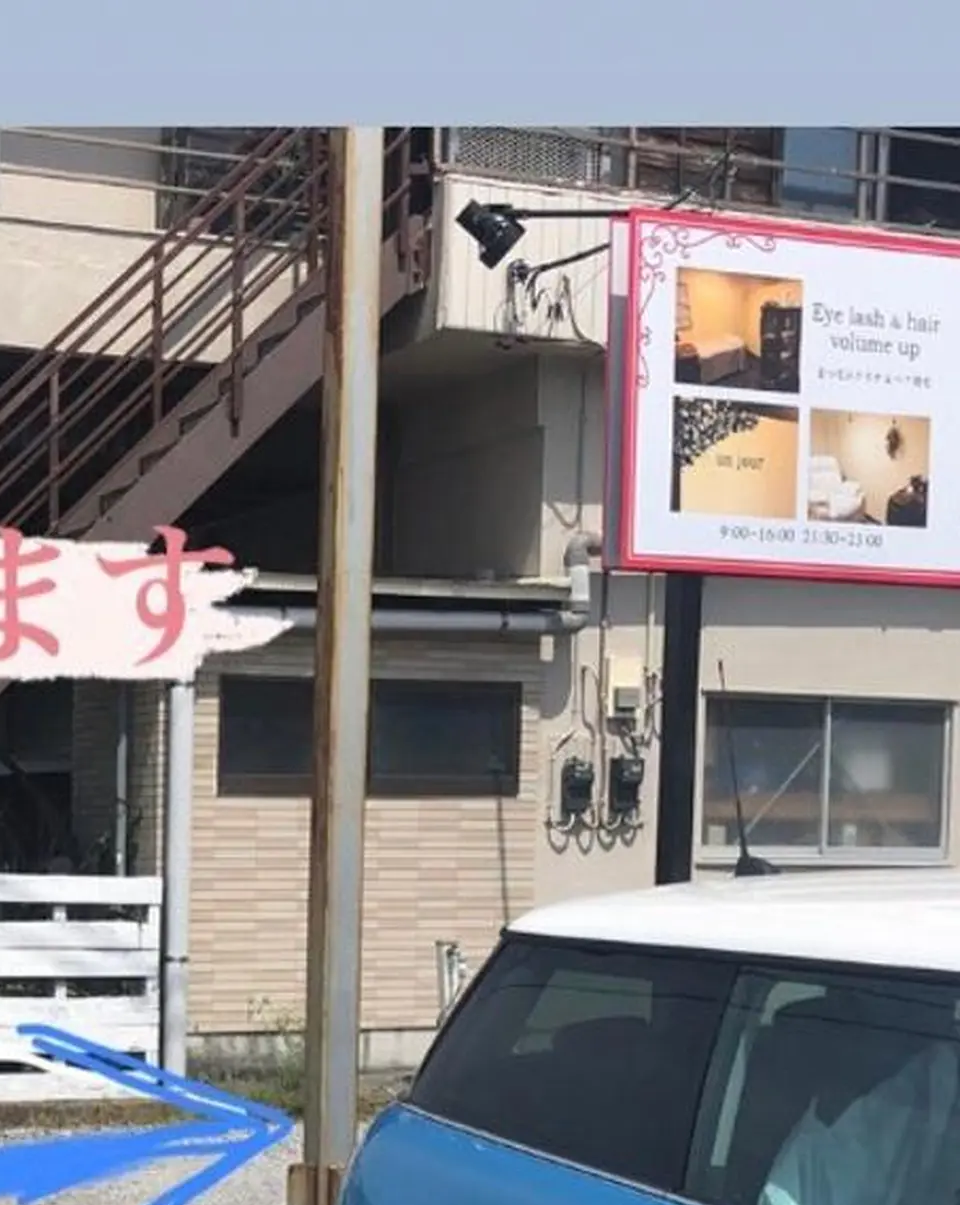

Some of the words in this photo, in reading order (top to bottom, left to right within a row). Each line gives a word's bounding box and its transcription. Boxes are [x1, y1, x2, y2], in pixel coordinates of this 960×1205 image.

[812, 302, 844, 328] Eye
[849, 305, 886, 330] lash
[906, 309, 941, 334] hair
[830, 331, 893, 354] volume
[897, 341, 921, 362] up
